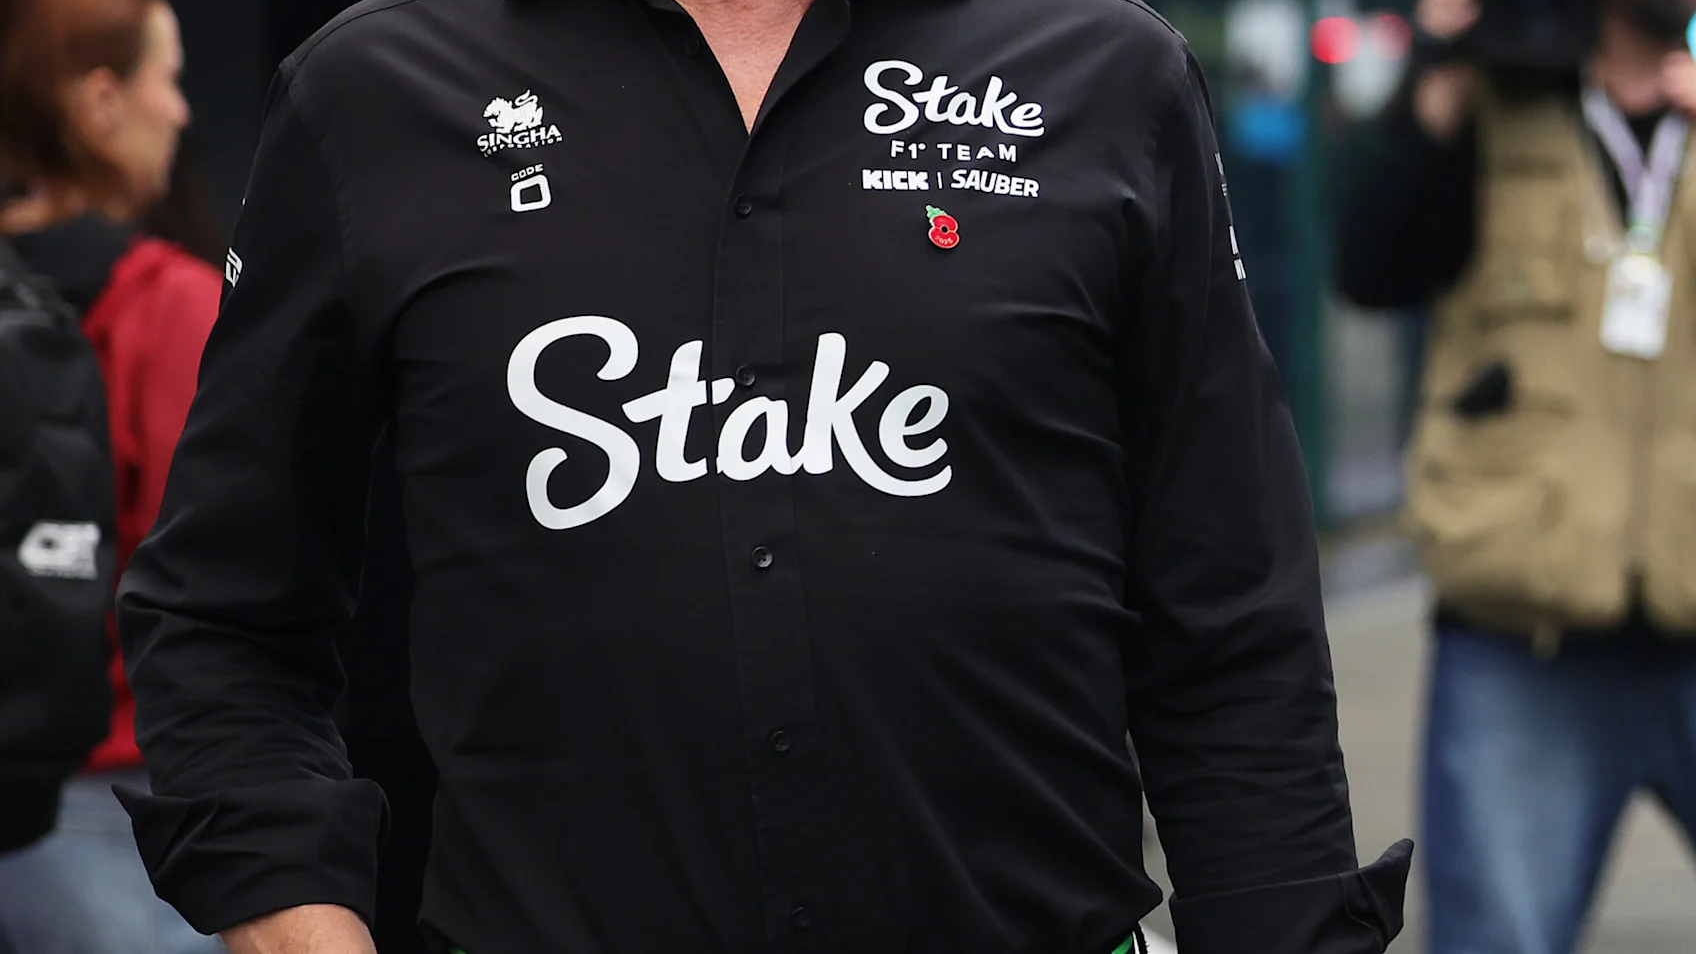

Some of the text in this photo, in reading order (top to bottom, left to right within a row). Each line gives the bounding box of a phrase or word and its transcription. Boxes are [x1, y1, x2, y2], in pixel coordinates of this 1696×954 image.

[863, 60, 1045, 137] Stake
[477, 124, 561, 152] SINGHA
[936, 143, 1017, 162] TEAM
[511, 164, 544, 181] CODE
[862, 169, 1039, 197] KICK SAUBER
[507, 315, 952, 530] Stake
